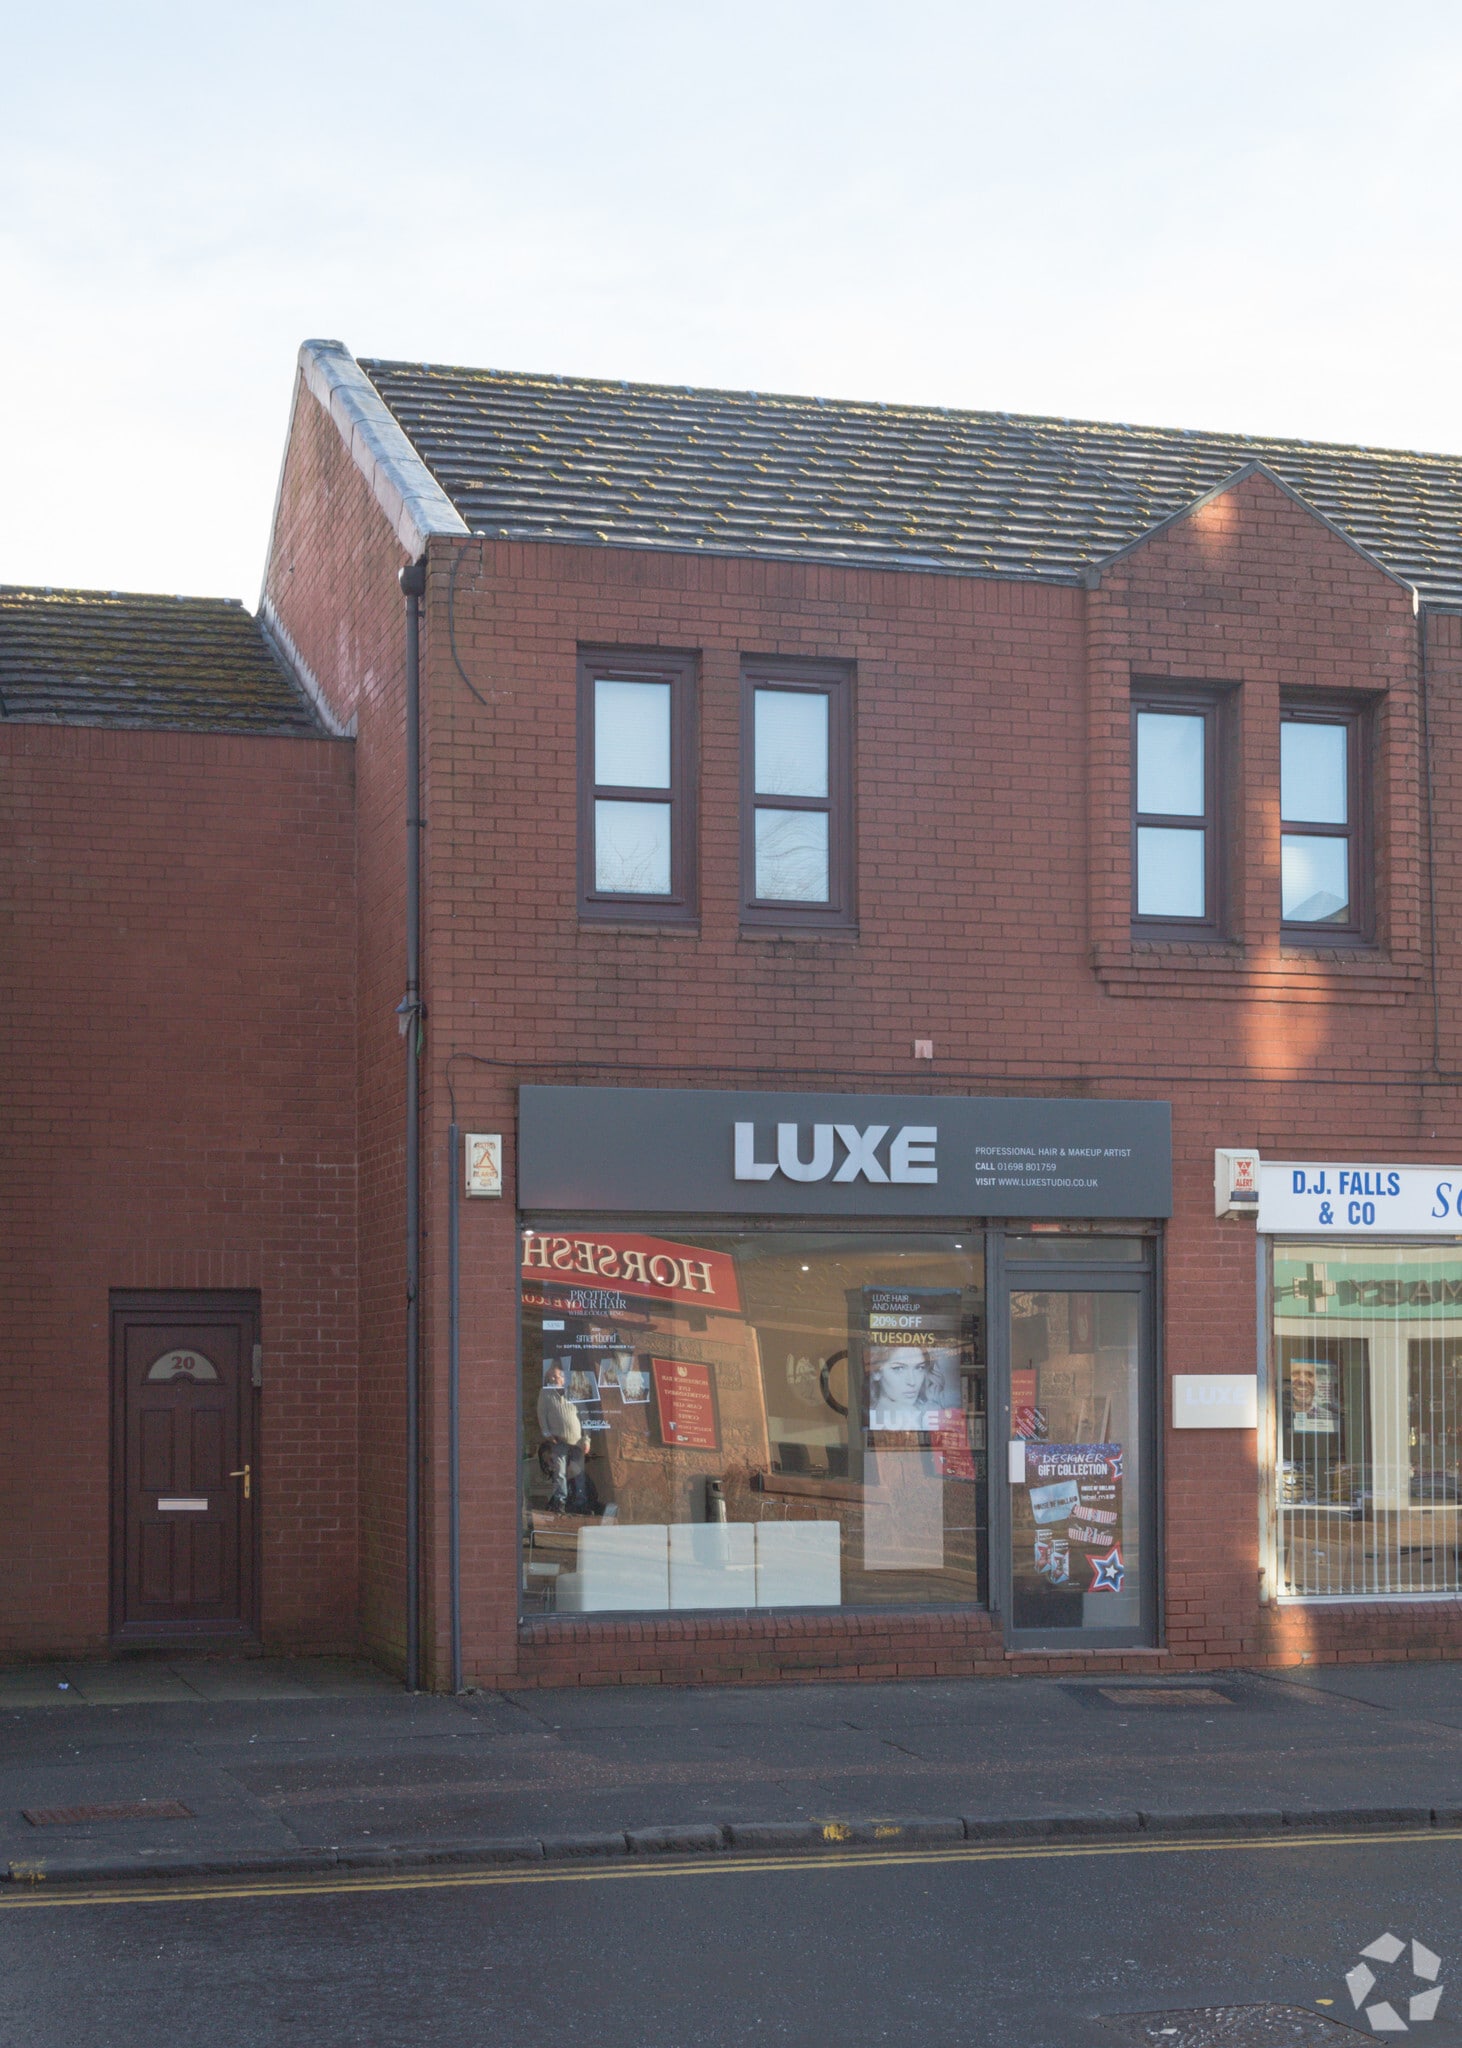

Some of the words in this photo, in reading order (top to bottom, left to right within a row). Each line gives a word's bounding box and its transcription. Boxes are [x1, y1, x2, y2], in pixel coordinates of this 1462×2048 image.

[734, 1121, 938, 1184] LUXE
[975, 1147, 1036, 1156] PROFESSIONAL
[1038, 1148, 1057, 1156] HAIR
[1059, 1148, 1066, 1156] &
[1068, 1148, 1102, 1157] MAKEUP
[1104, 1148, 1131, 1157] ARTIST
[975, 1162, 995, 1171] CALL
[997, 1162, 1023, 1171] 01698
[1025, 1163, 1057, 1171] 801759
[975, 1177, 996, 1186] VISIT
[998, 1178, 1098, 1187] WWW.LUXESTUDIO.CO.UK
[1236, 1178, 1253, 1187] ALERT
[1292, 1170, 1331, 1194] D.J.
[1339, 1171, 1400, 1196] FALLS
[1431, 1182, 1462, 1218] S
[1319, 1201, 1334, 1225] &
[1348, 1201, 1375, 1225] CO
[570, 1289, 623, 1300] PROTECT
[892, 1294, 909, 1302] HAIR
[565, 1299, 598, 1309] YOUR
[599, 1300, 627, 1310] HAIR
[872, 1303, 889, 1311] AND
[890, 1303, 921, 1311] MAKEUP
[872, 1315, 897, 1327] 20%
[899, 1316, 922, 1328] OFF
[871, 1331, 935, 1344] TUESDAYS
[171, 1356, 195, 1370] 20
[1185, 1386, 1249, 1406] LUXE
[869, 1409, 940, 1431] LUXE
[1042, 1453, 1104, 1464] DESIGNER
[1038, 1464, 1056, 1476] GIFT
[1057, 1463, 1108, 1476] COLLECTION
